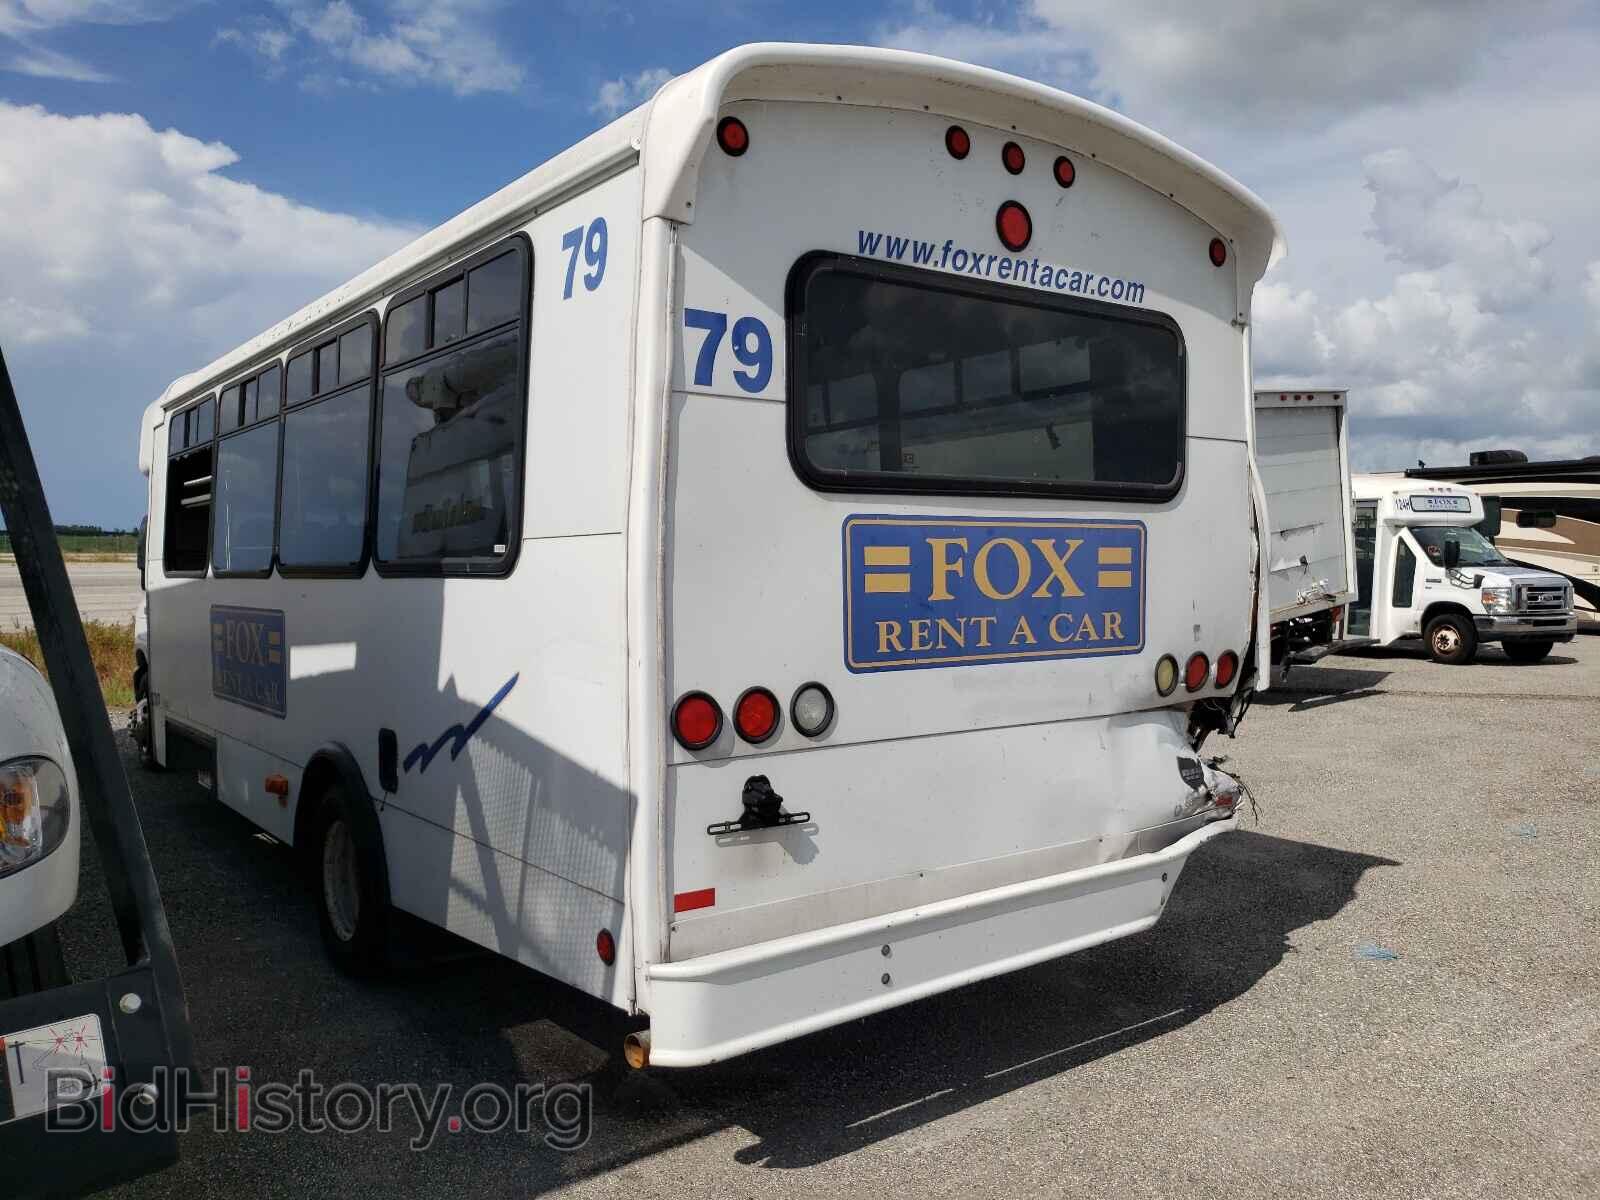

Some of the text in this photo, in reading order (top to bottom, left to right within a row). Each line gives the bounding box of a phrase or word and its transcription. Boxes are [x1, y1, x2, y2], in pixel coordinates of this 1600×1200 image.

[561, 216, 608, 300] 79
[858, 230, 1145, 303] www.foxrentacar.com
[684, 308, 773, 393] 79
[925, 538, 1086, 601] FOX
[225, 619, 265, 667] FOX
[875, 611, 1126, 653] RENT A CAR
